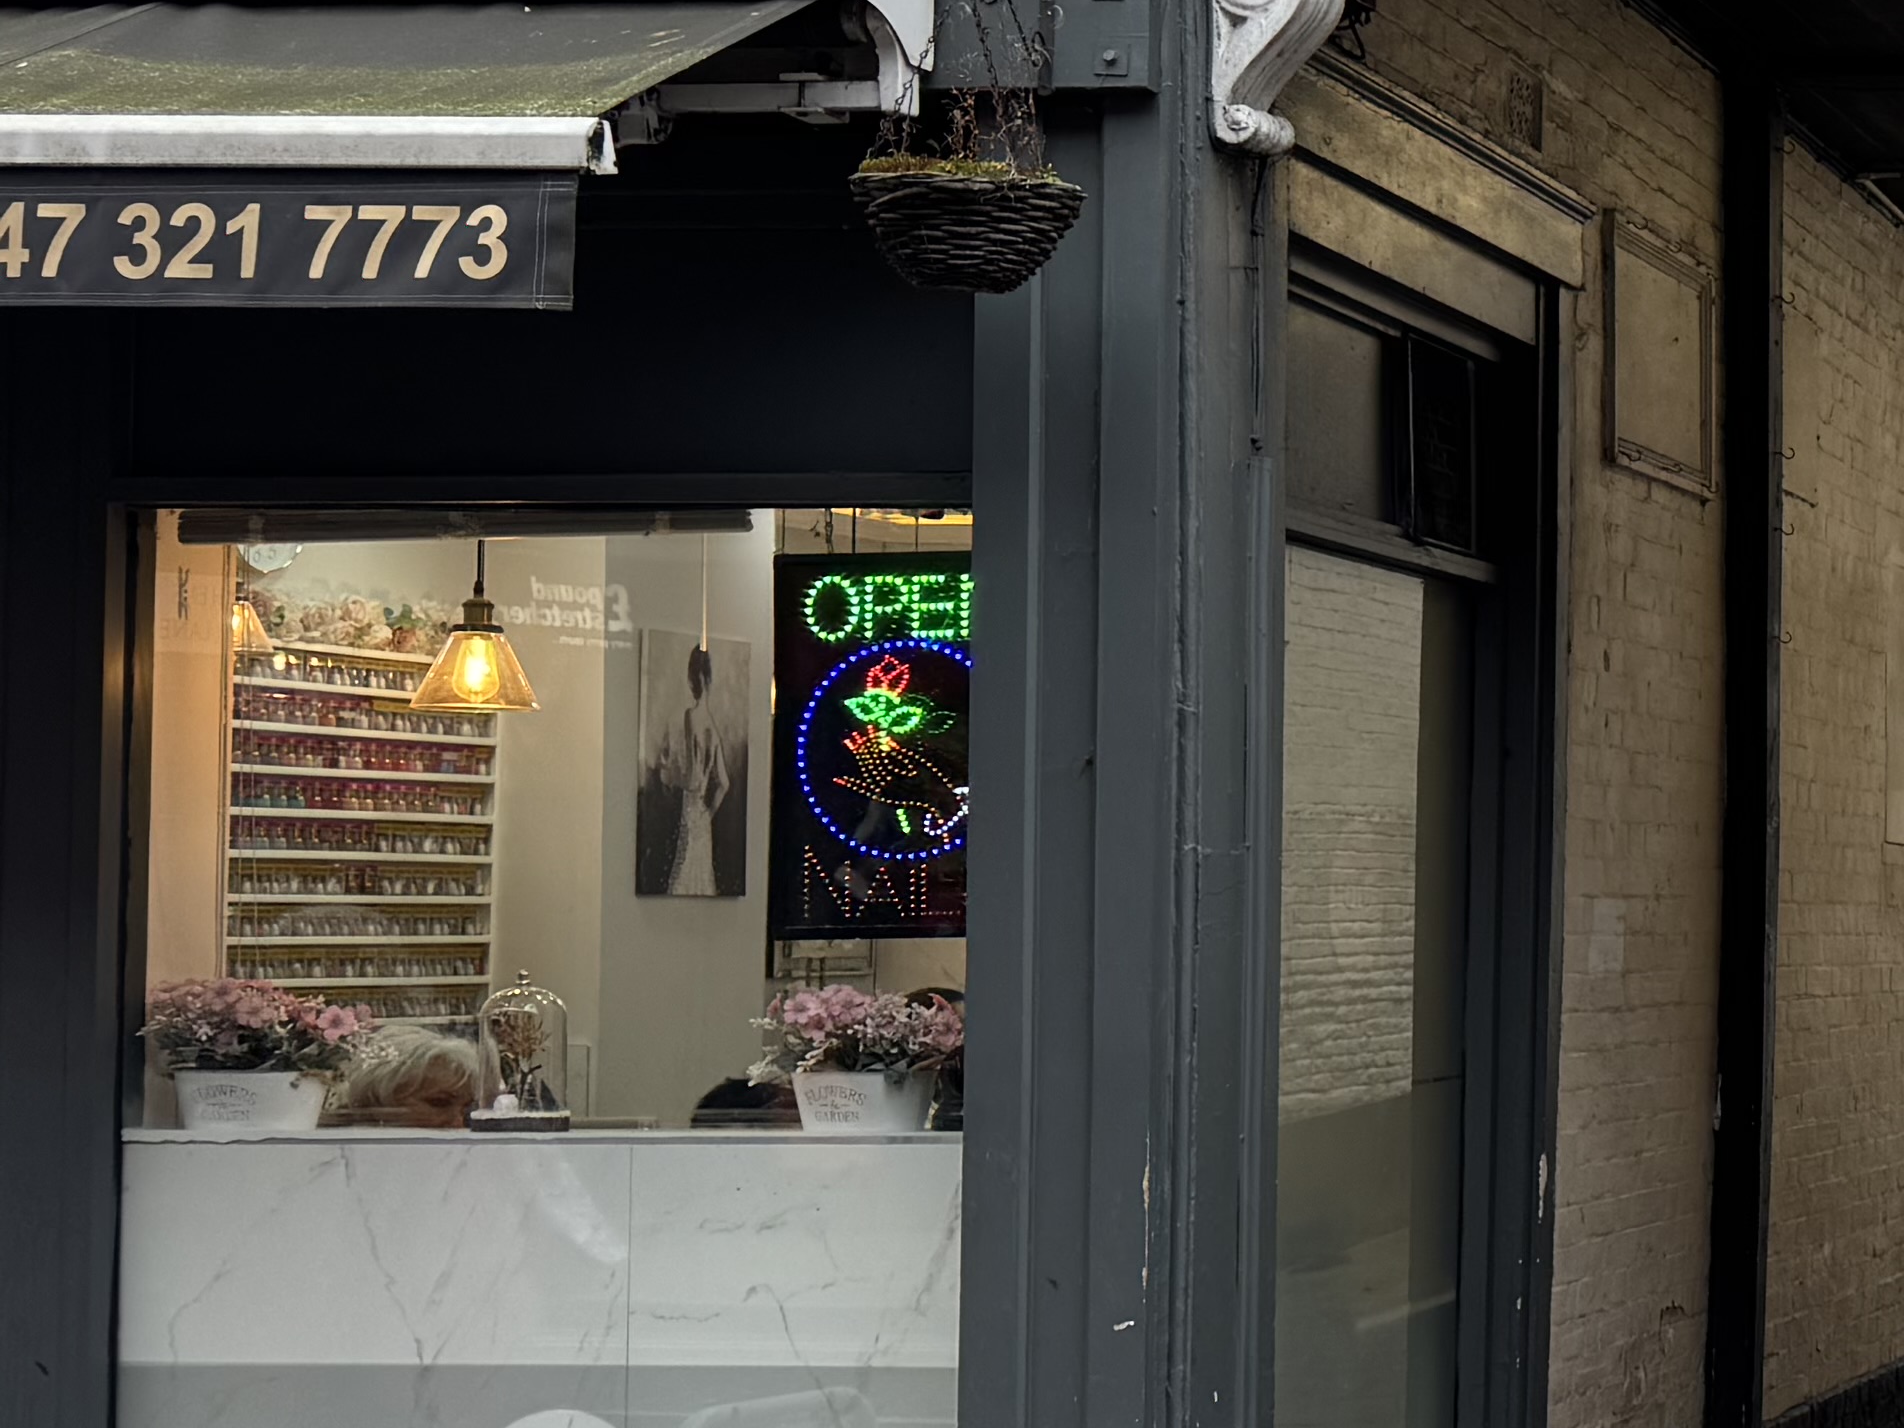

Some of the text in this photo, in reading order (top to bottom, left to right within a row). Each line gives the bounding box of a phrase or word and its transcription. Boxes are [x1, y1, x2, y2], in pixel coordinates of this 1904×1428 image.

[113, 202, 261, 279] 321
[304, 204, 508, 280] 7773
[805, 574, 973, 642] OPE
